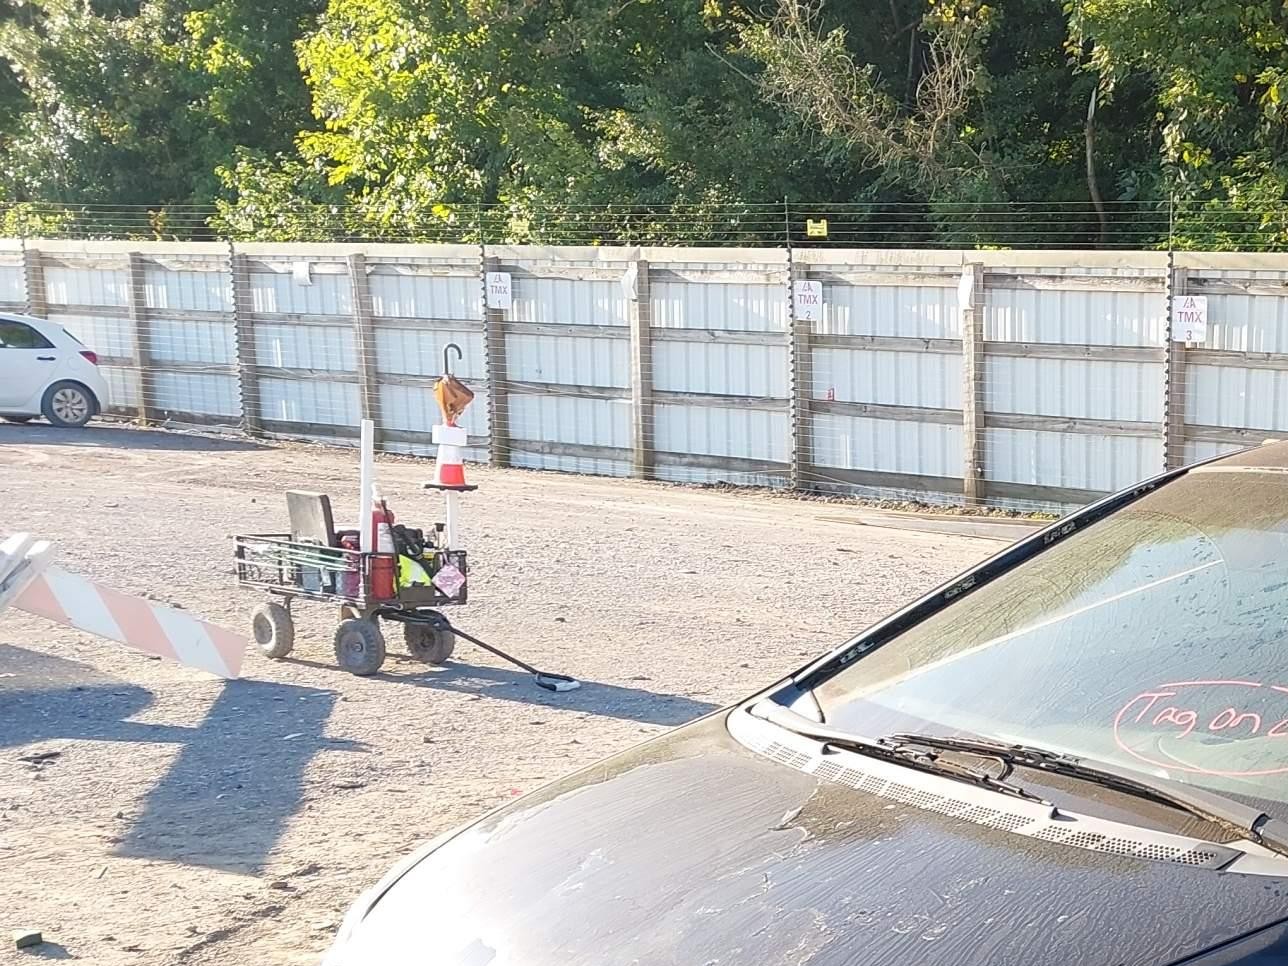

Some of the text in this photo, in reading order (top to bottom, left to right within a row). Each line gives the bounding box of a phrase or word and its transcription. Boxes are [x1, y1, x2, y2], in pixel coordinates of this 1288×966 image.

[490, 285, 508, 295] TMX
[798, 295, 818, 305] TMX
[805, 311, 811, 320] 2
[1177, 311, 1202, 323] TMX
[1186, 330, 1193, 341] 3
[1134, 691, 1198, 739] Tag
